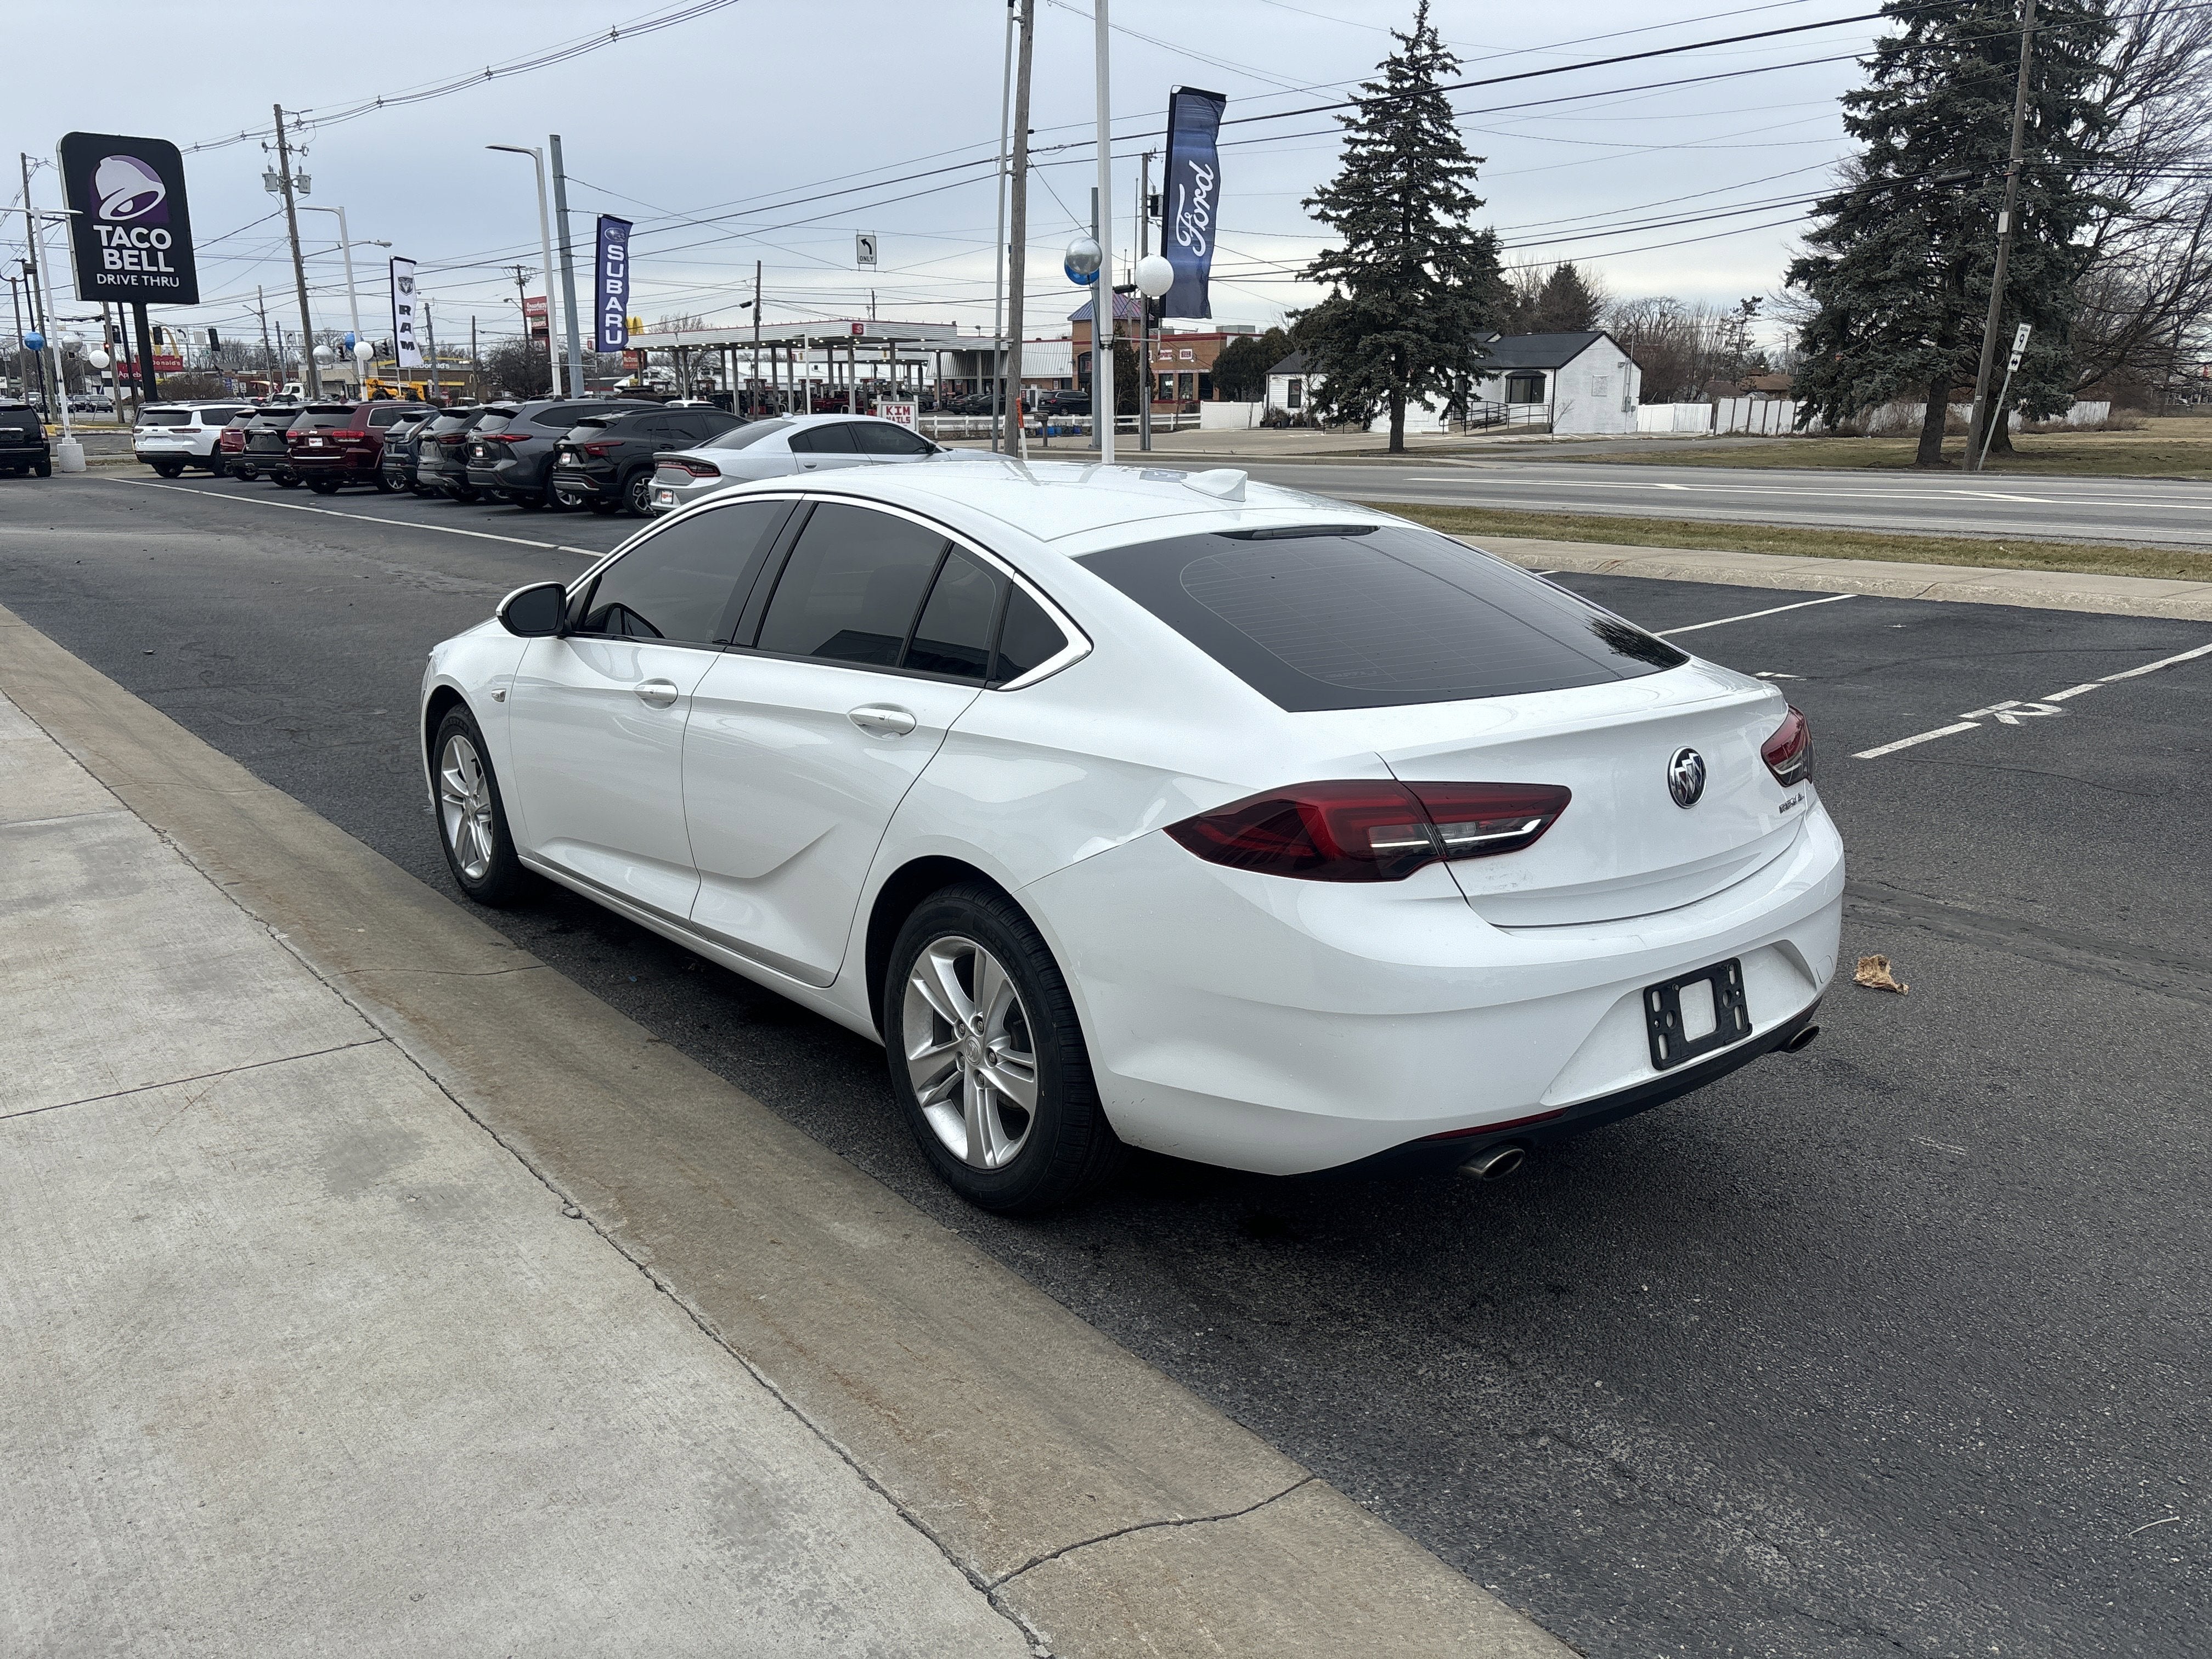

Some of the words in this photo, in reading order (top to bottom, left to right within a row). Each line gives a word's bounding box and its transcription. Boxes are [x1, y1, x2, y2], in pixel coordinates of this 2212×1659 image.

[1176, 160, 1214, 256] Ford
[93, 224, 172, 250] TACO
[103, 249, 174, 272] BELL
[96, 273, 138, 286] DRIVE
[141, 275, 179, 287] THRU
[605, 244, 624, 345] SUBARU
[399, 304, 415, 351] RAM
[2018, 333, 2025, 349] 9
[886, 406, 910, 415] KIM
